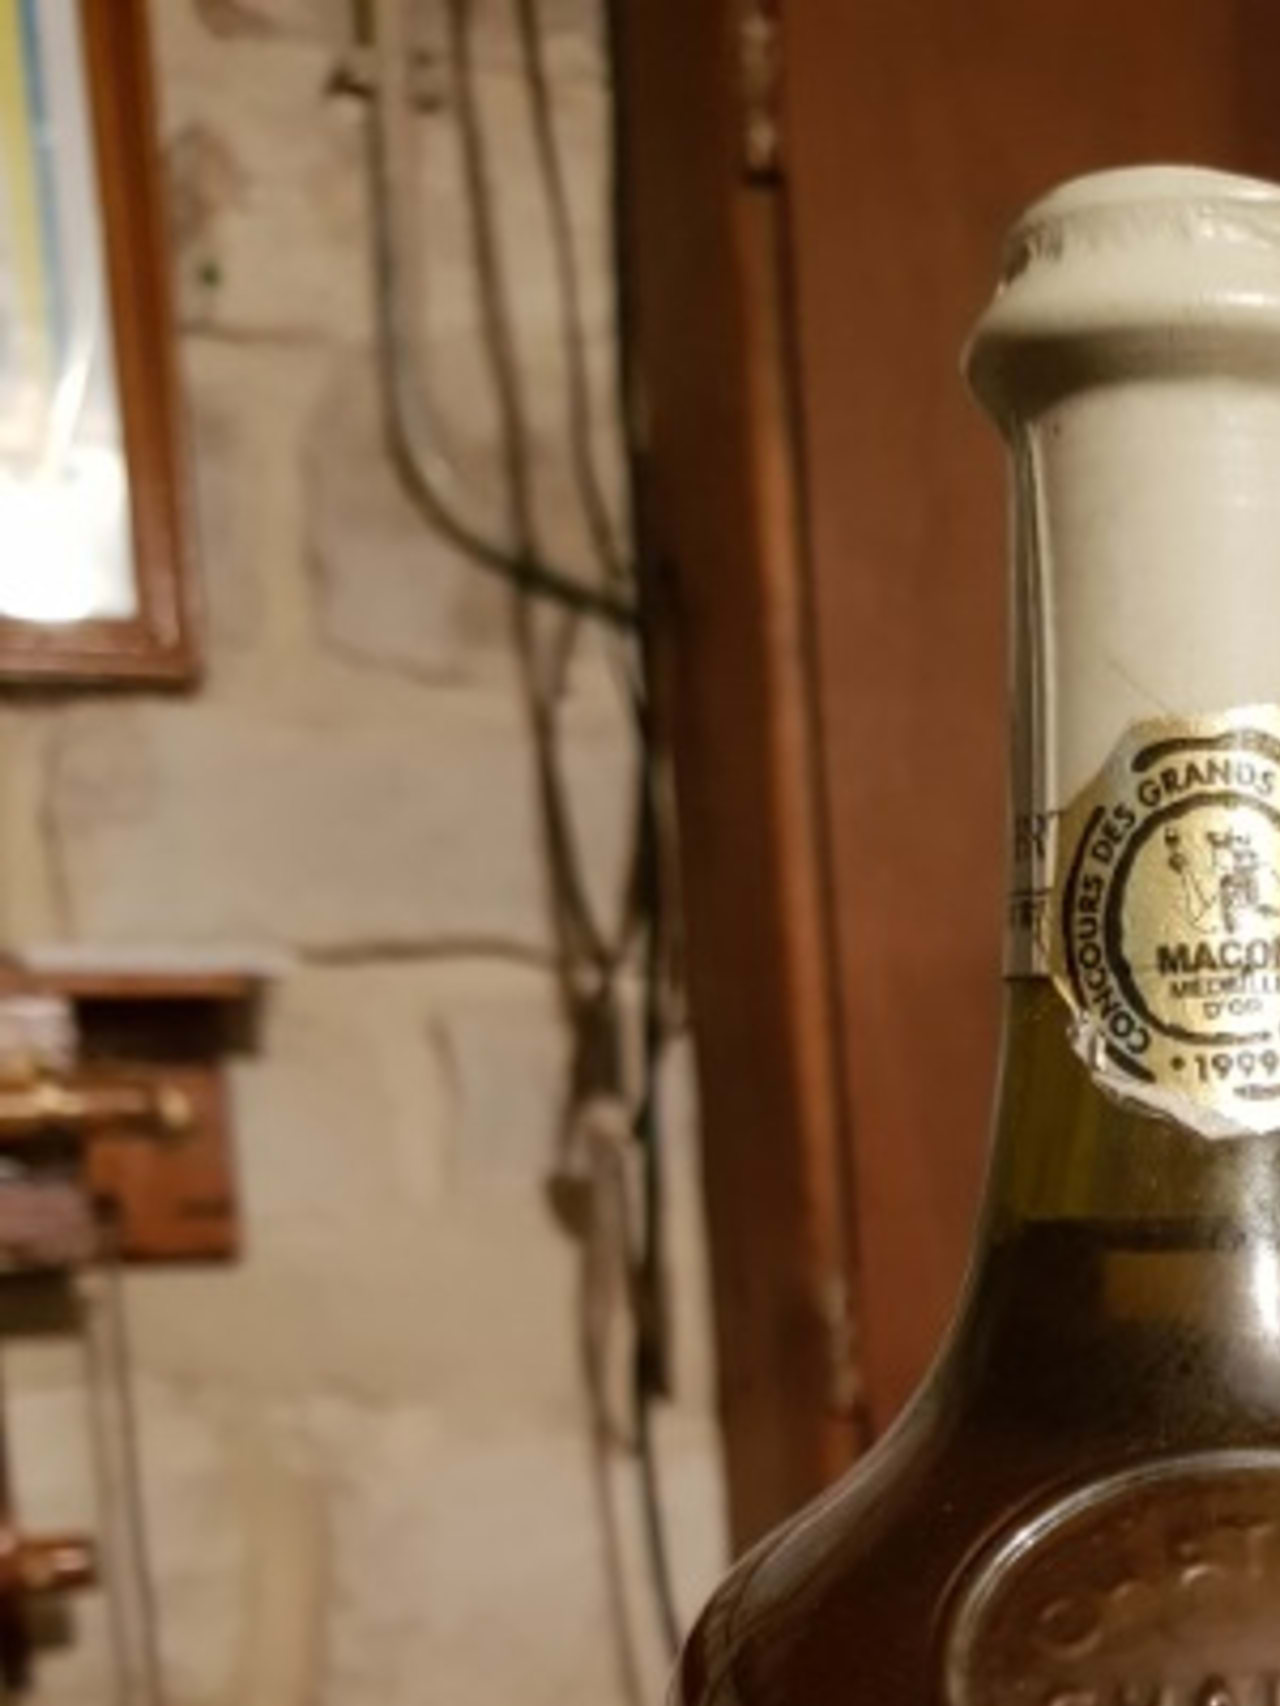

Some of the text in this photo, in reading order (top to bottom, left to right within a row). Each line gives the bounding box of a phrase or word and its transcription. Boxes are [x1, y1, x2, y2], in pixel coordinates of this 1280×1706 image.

[1136, 758, 1275, 808] GRANDS
[1091, 803, 1136, 864] DES
[1076, 875, 1152, 1056] CONCOURS
